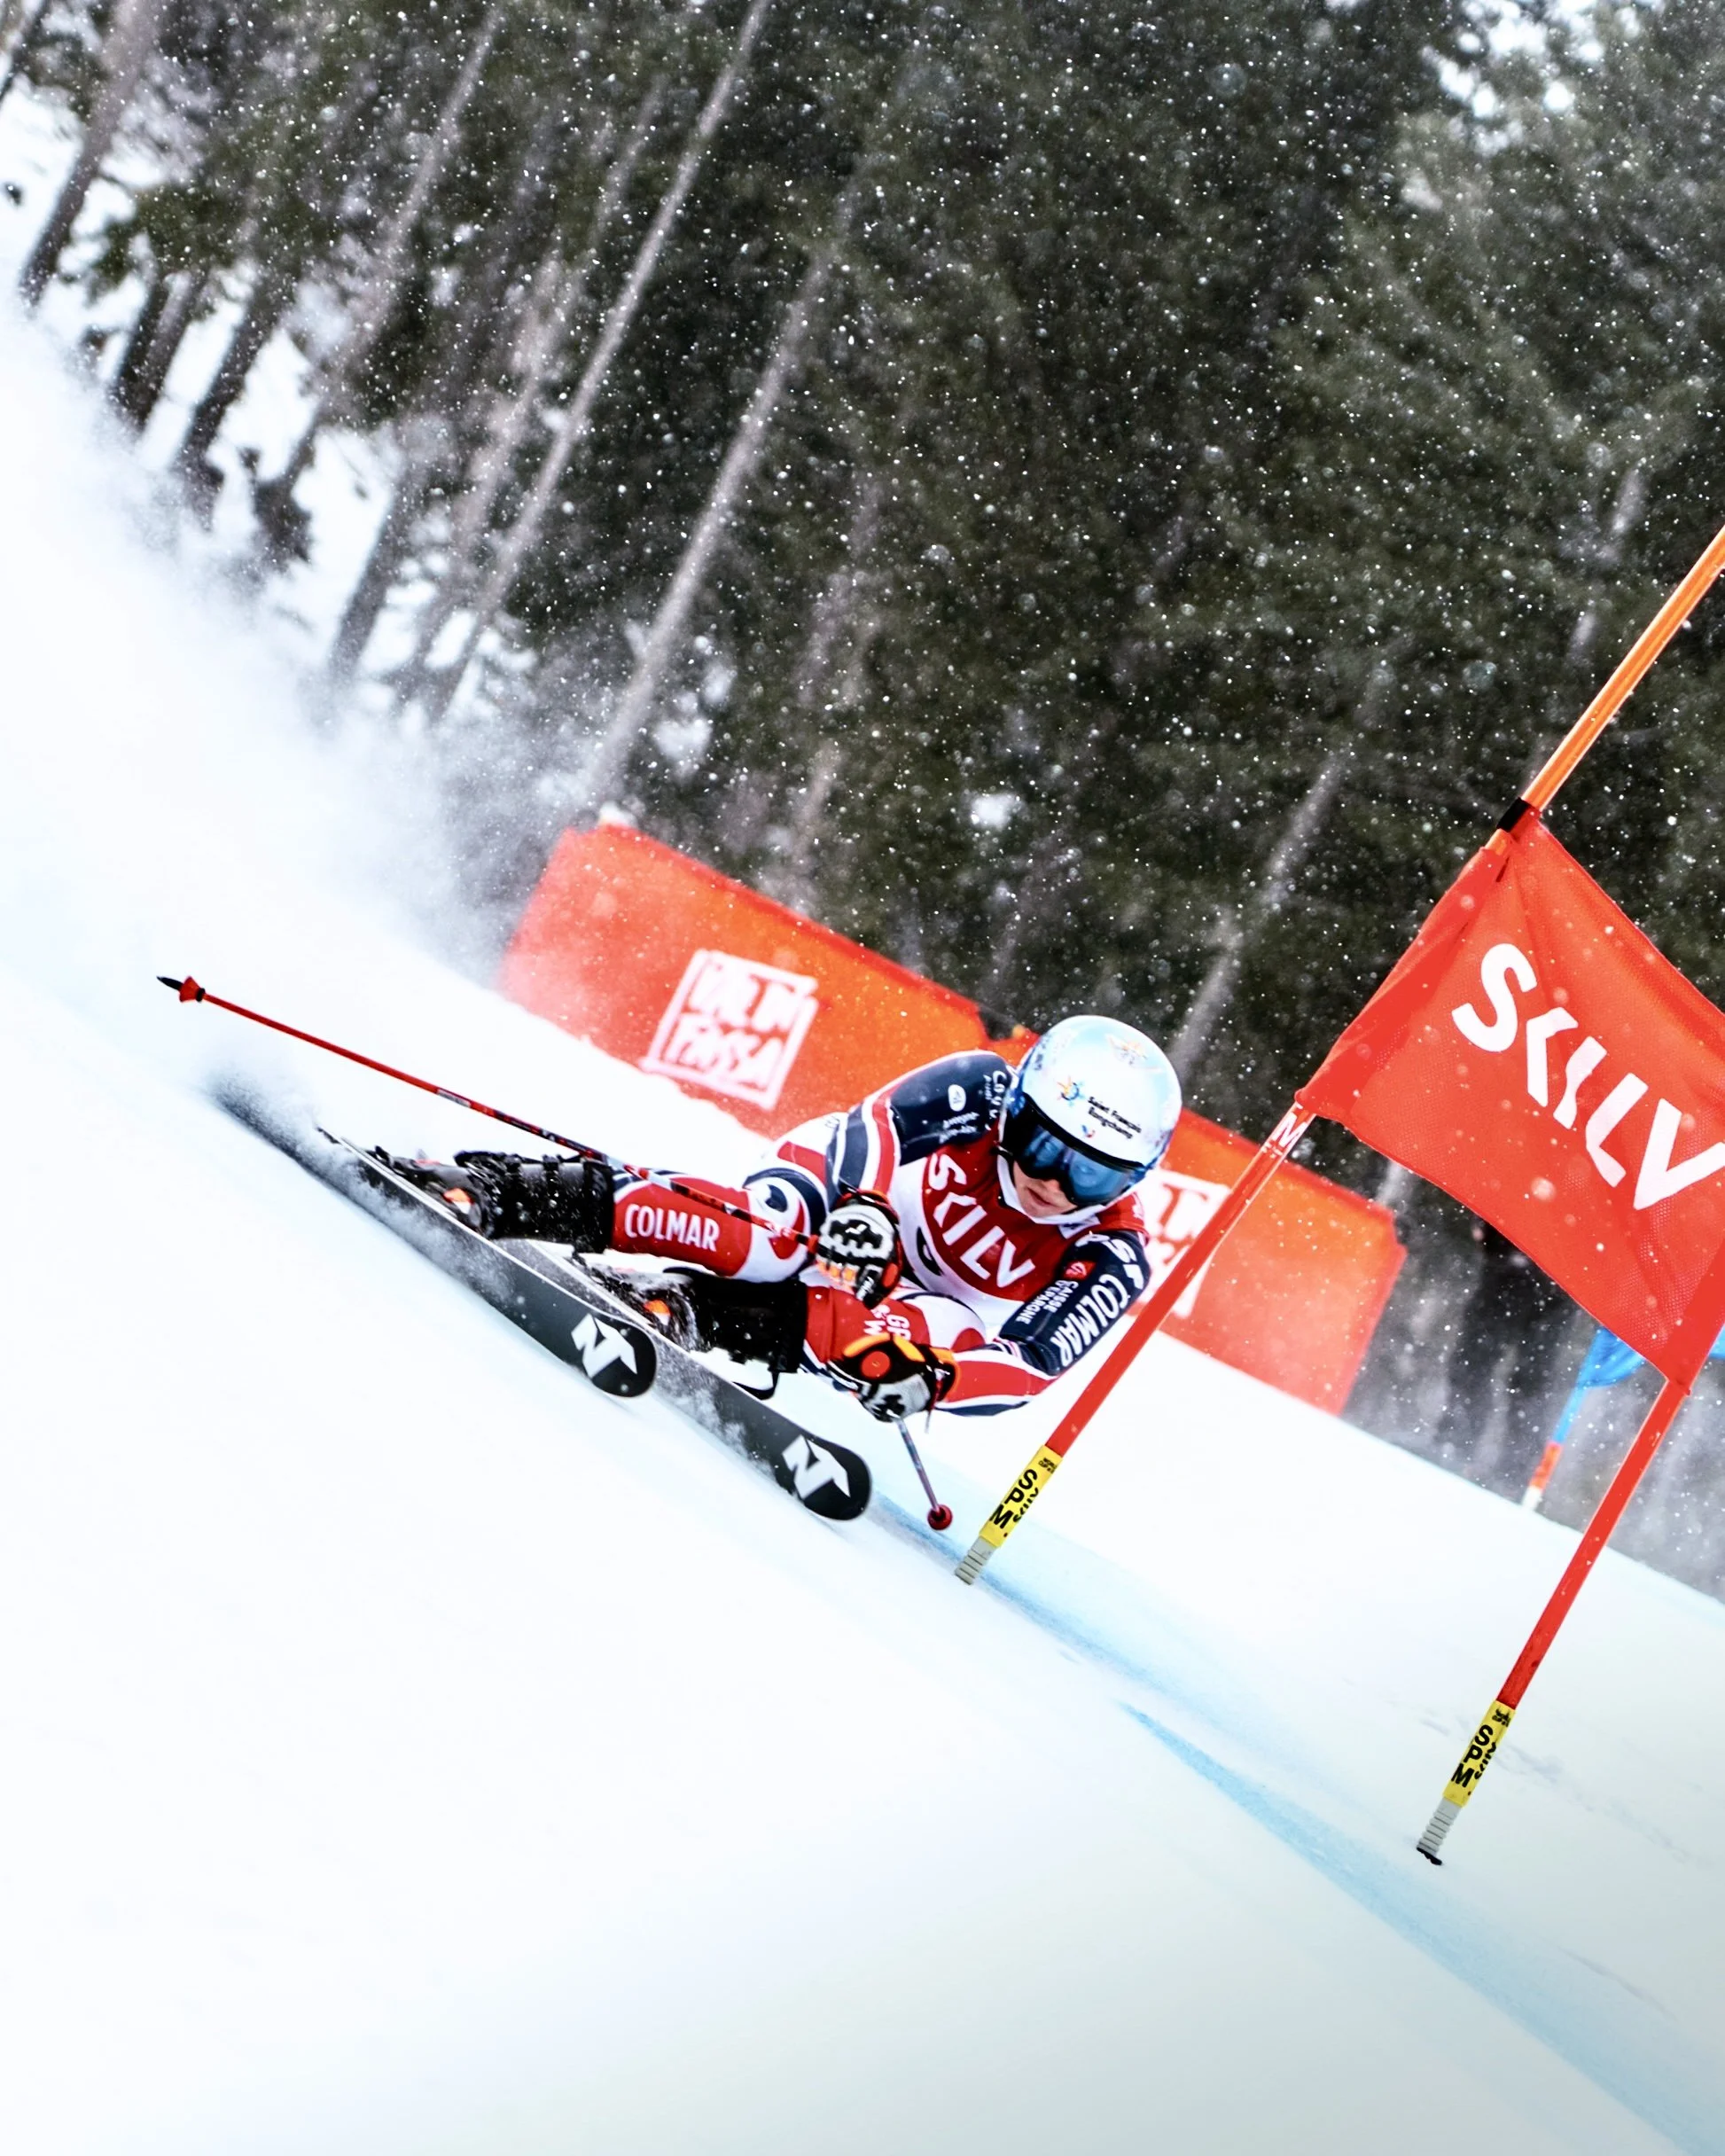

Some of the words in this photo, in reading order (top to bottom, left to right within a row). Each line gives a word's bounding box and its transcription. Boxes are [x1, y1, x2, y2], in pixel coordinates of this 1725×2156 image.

[624, 1203, 721, 1252] COLMAR
[928, 1152, 1035, 1288] SKILV
[1044, 1280, 1079, 1313] CAISSE
[1050, 1274, 1131, 1367] COLMAR
